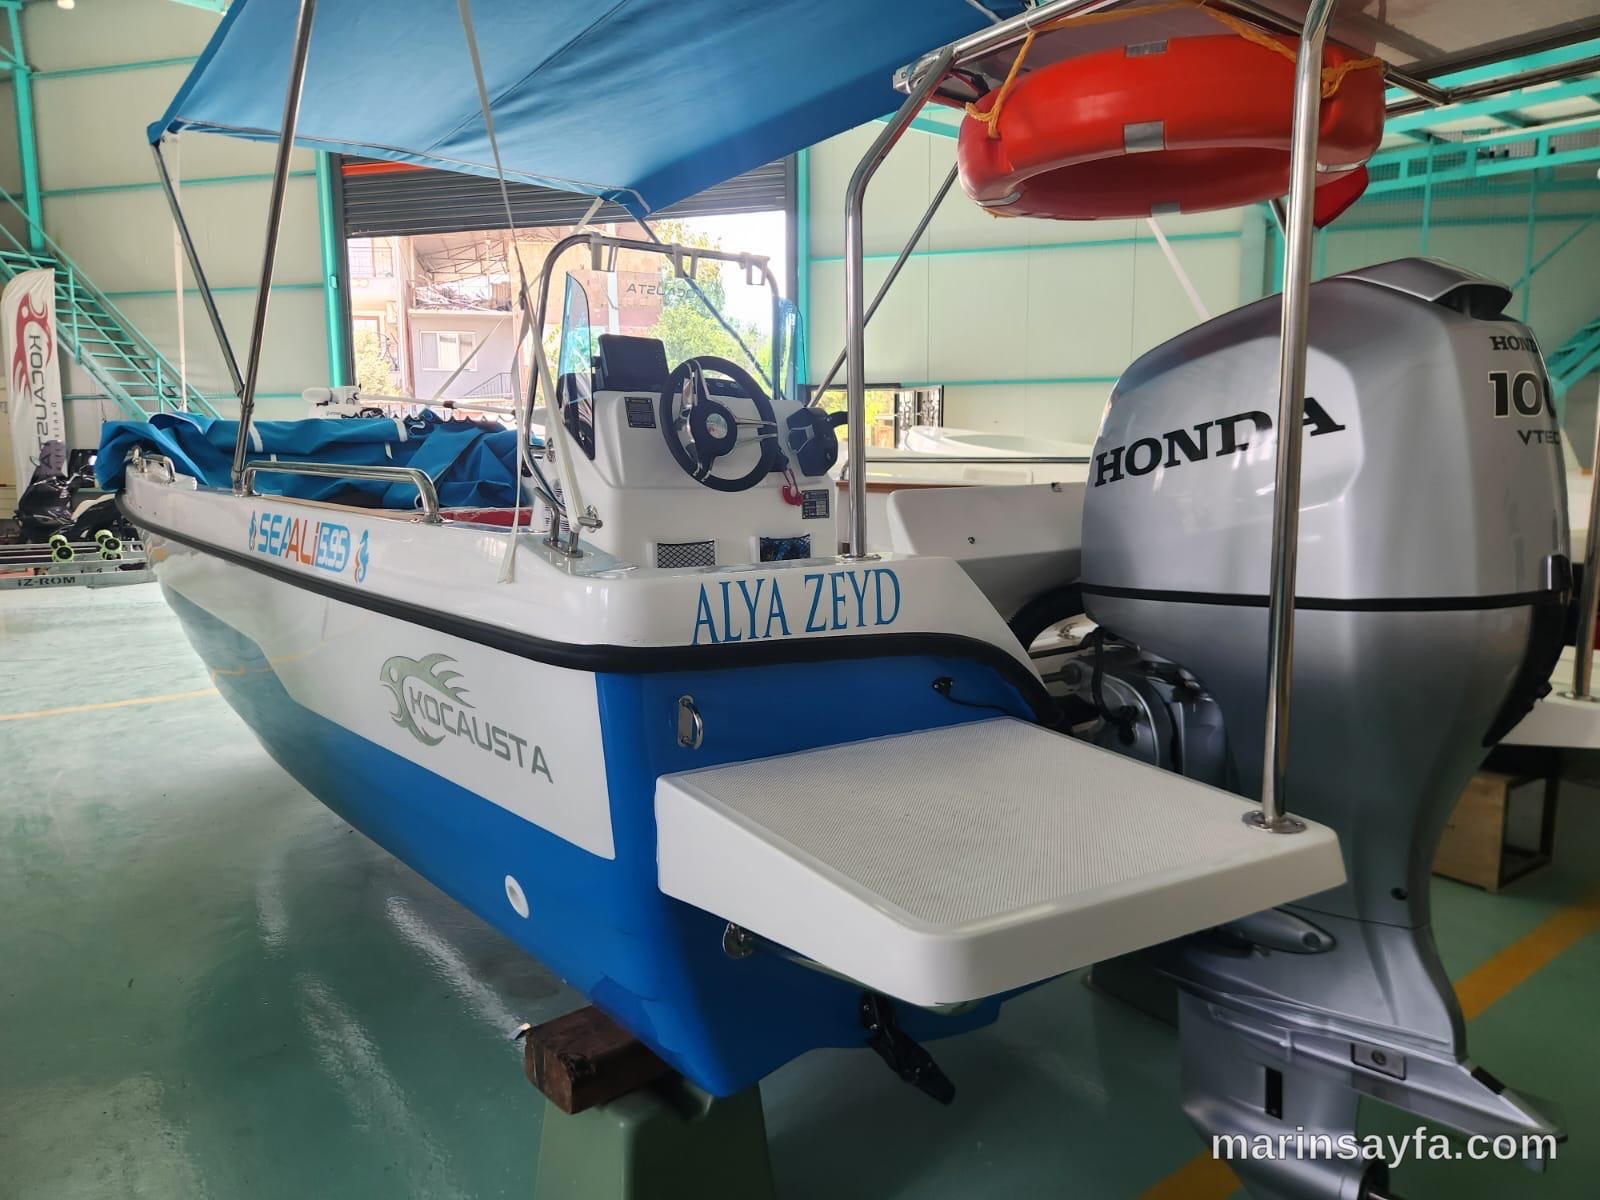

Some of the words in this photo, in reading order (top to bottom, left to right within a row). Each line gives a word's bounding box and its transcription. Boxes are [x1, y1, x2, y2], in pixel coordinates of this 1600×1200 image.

[1094, 396, 1347, 488] HONDA
[691, 576, 793, 645] ALYA
[804, 568, 901, 633] ZEYD
[408, 686, 554, 784] KOCAUSTA
